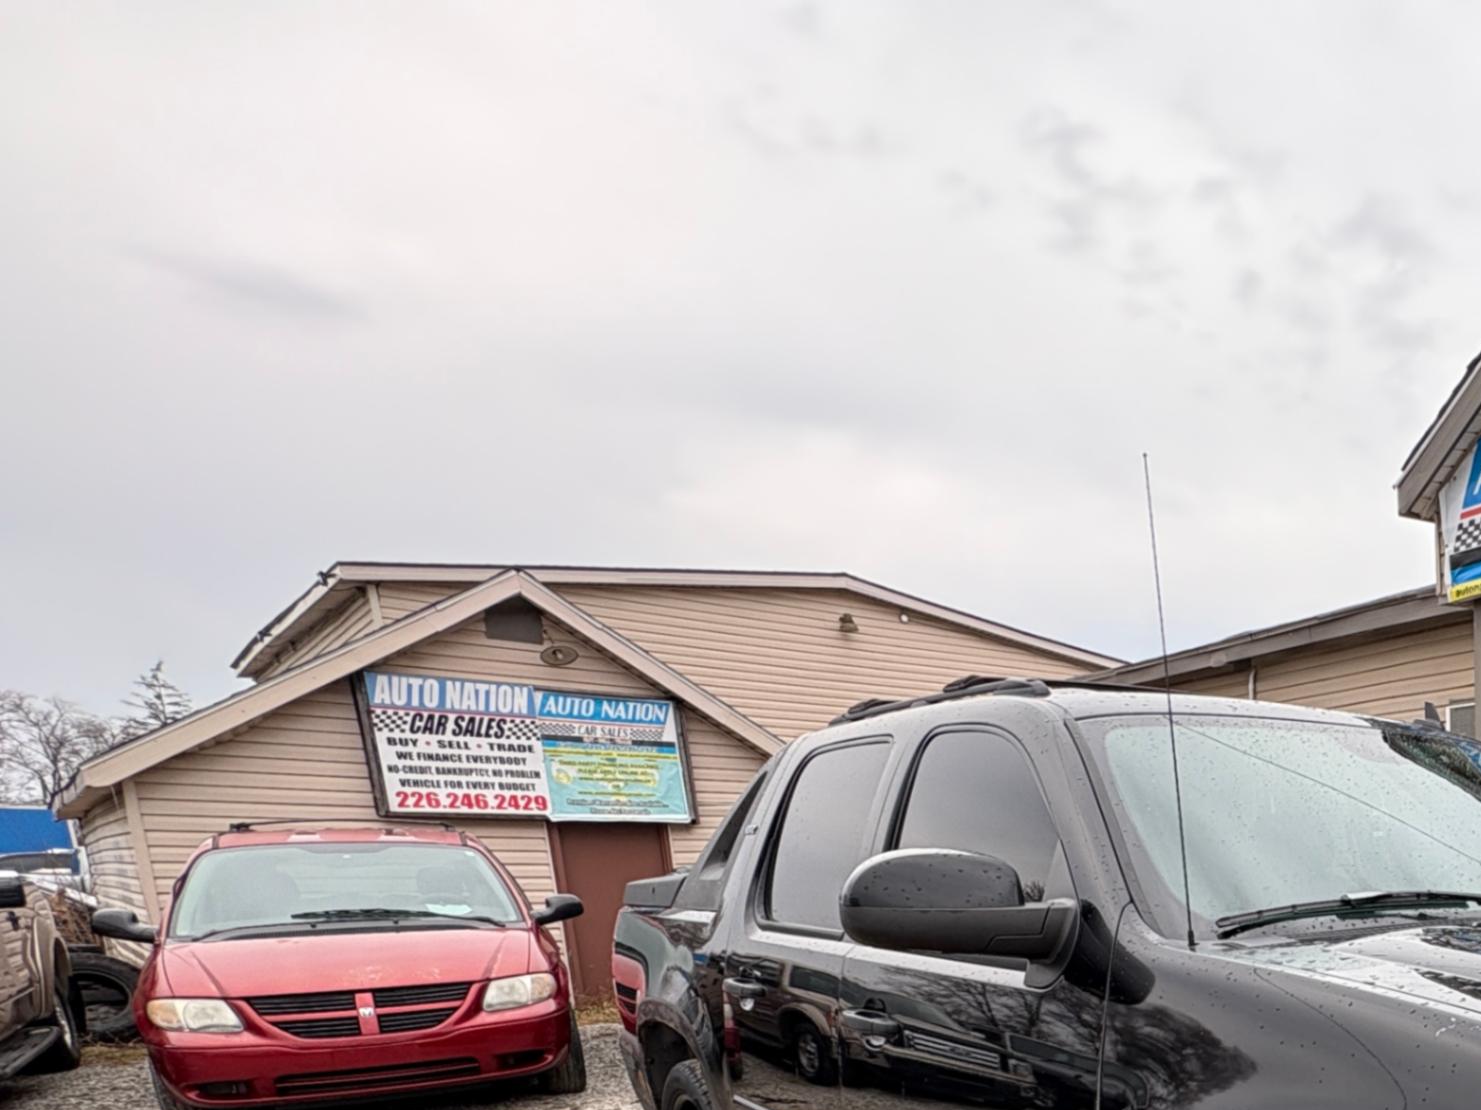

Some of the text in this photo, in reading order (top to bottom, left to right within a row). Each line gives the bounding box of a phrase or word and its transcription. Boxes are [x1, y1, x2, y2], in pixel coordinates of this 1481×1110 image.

[374, 674, 528, 715] AUTO NATION
[543, 695, 667, 723] AUTO NATION
[409, 712, 507, 740] CAR SALES
[577, 724, 629, 738] CAR SALES
[386, 736, 419, 748] BUY
[436, 739, 472, 751] SELL
[487, 742, 536, 754] TRADE
[395, 750, 527, 767] WE FINANCE EVERYBODY
[399, 778, 537, 792] VEHICLE FOR EVERY BUDGET
[395, 790, 549, 812] 226.246.2429
